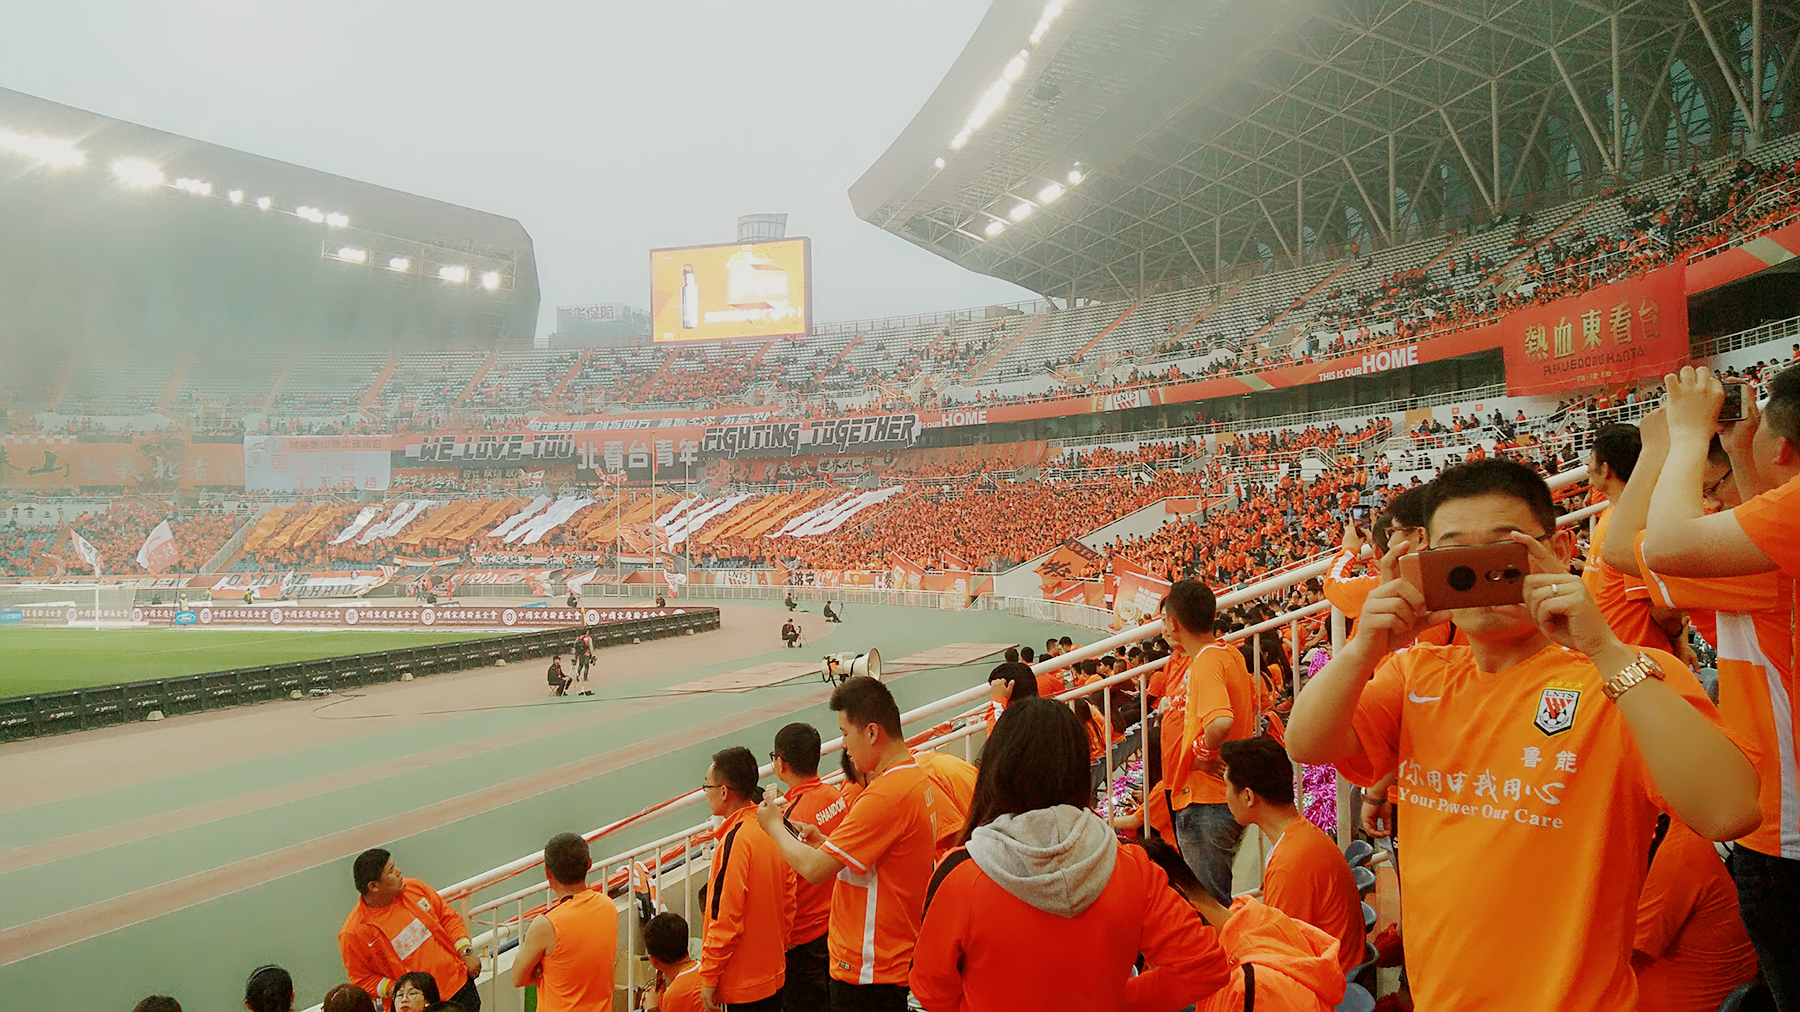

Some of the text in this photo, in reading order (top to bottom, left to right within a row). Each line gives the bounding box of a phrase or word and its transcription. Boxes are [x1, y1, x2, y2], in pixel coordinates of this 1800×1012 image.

[1318, 345, 1419, 382] THIS IS OUR HOME
[941, 410, 987, 427] HOME
[419, 433, 575, 461] WE LOVE YOU
[702, 414, 919, 459] FIGHTING TOGETHER
[577, 438, 699, 470] 北看台青年
[1398, 787, 1436, 809] Your
[1481, 804, 1509, 820] Our
[1514, 808, 1564, 829] Care
